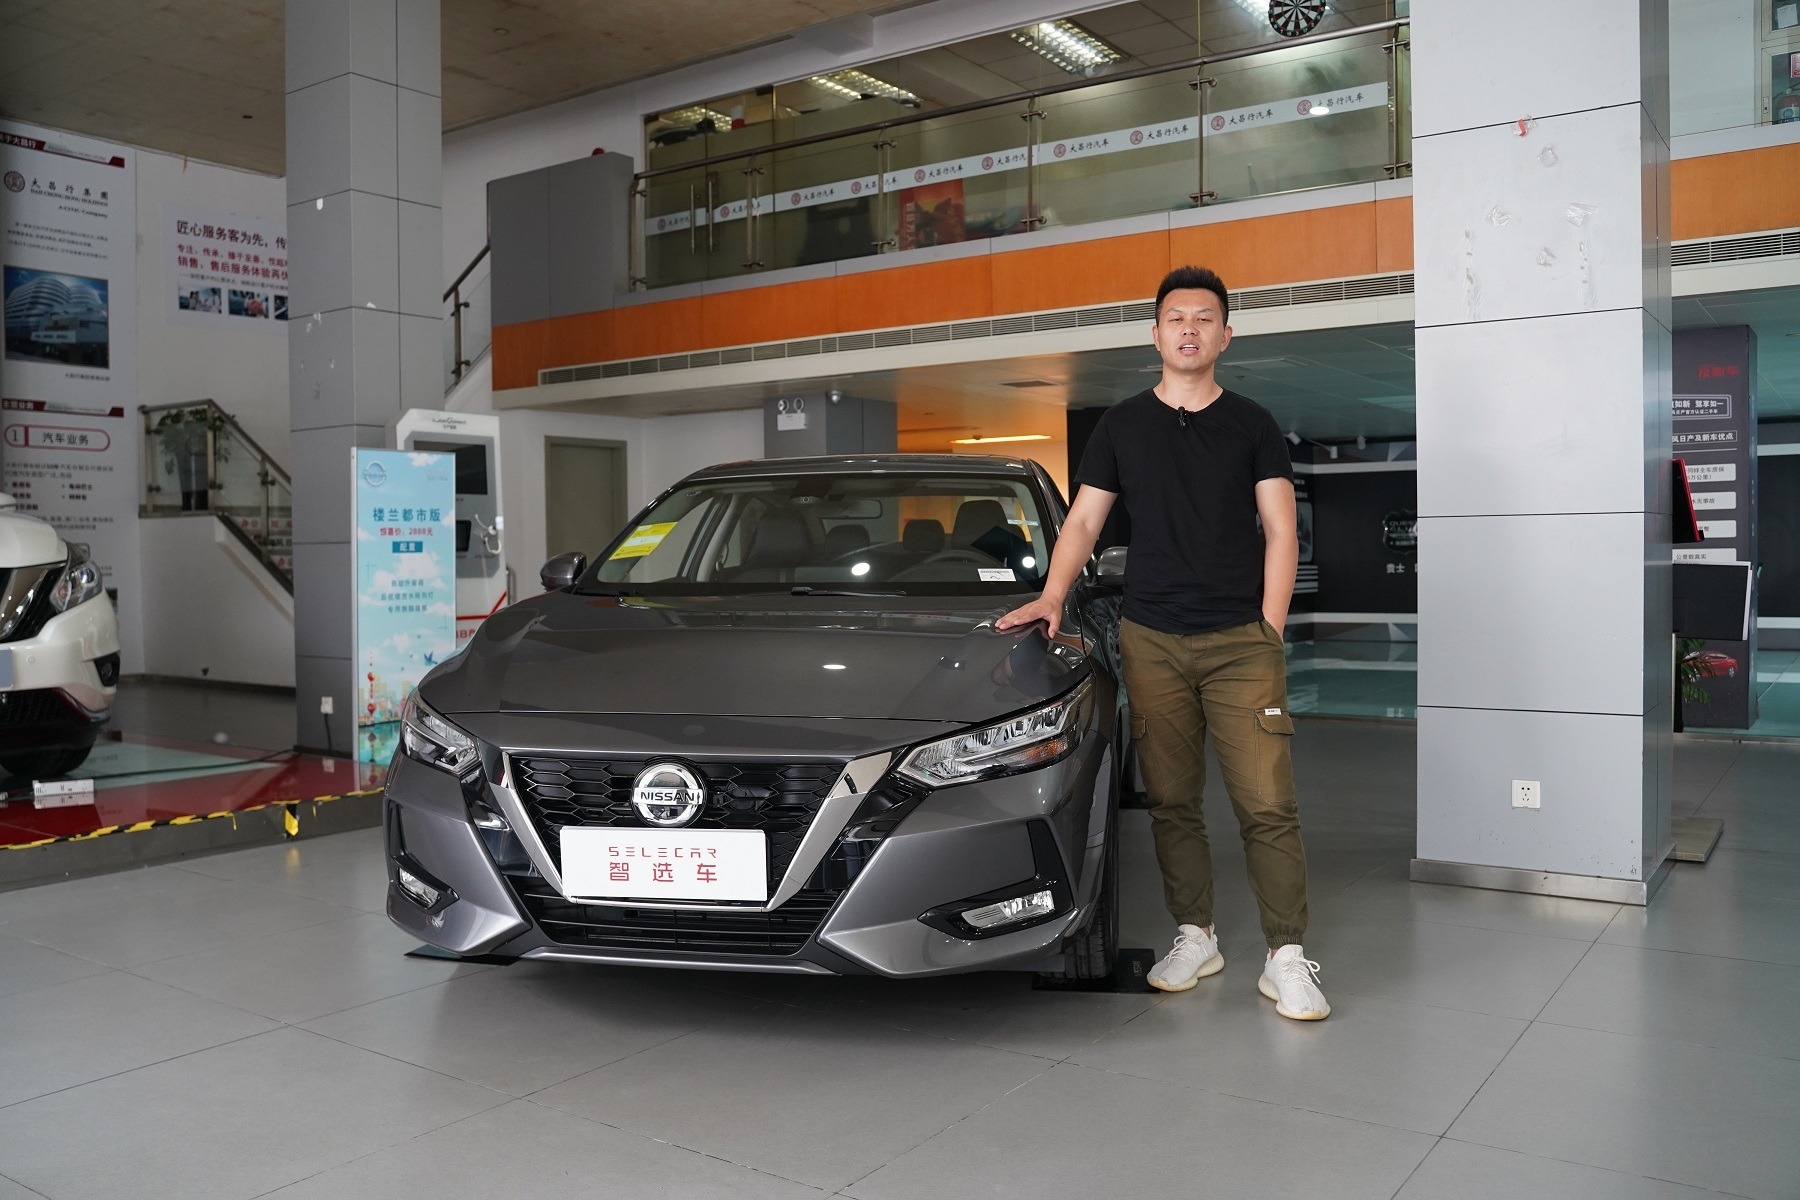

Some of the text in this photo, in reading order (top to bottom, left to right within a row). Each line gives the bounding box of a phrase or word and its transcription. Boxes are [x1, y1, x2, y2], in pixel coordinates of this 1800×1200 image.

[1228, 108, 1274, 126] 大昌行汽车
[1146, 124, 1189, 140] 大昌行汽车
[1069, 138, 1109, 153] 大昌行汽车
[928, 164, 963, 178] 大昌行汽车
[12, 428, 18, 442] 1
[42, 431, 90, 446] 汽车业务
[373, 507, 441, 523] 楼兰都市版
[640, 791, 695, 802] NISSAN
[608, 846, 717, 859] SELECAR
[609, 862, 718, 883] 智选车
